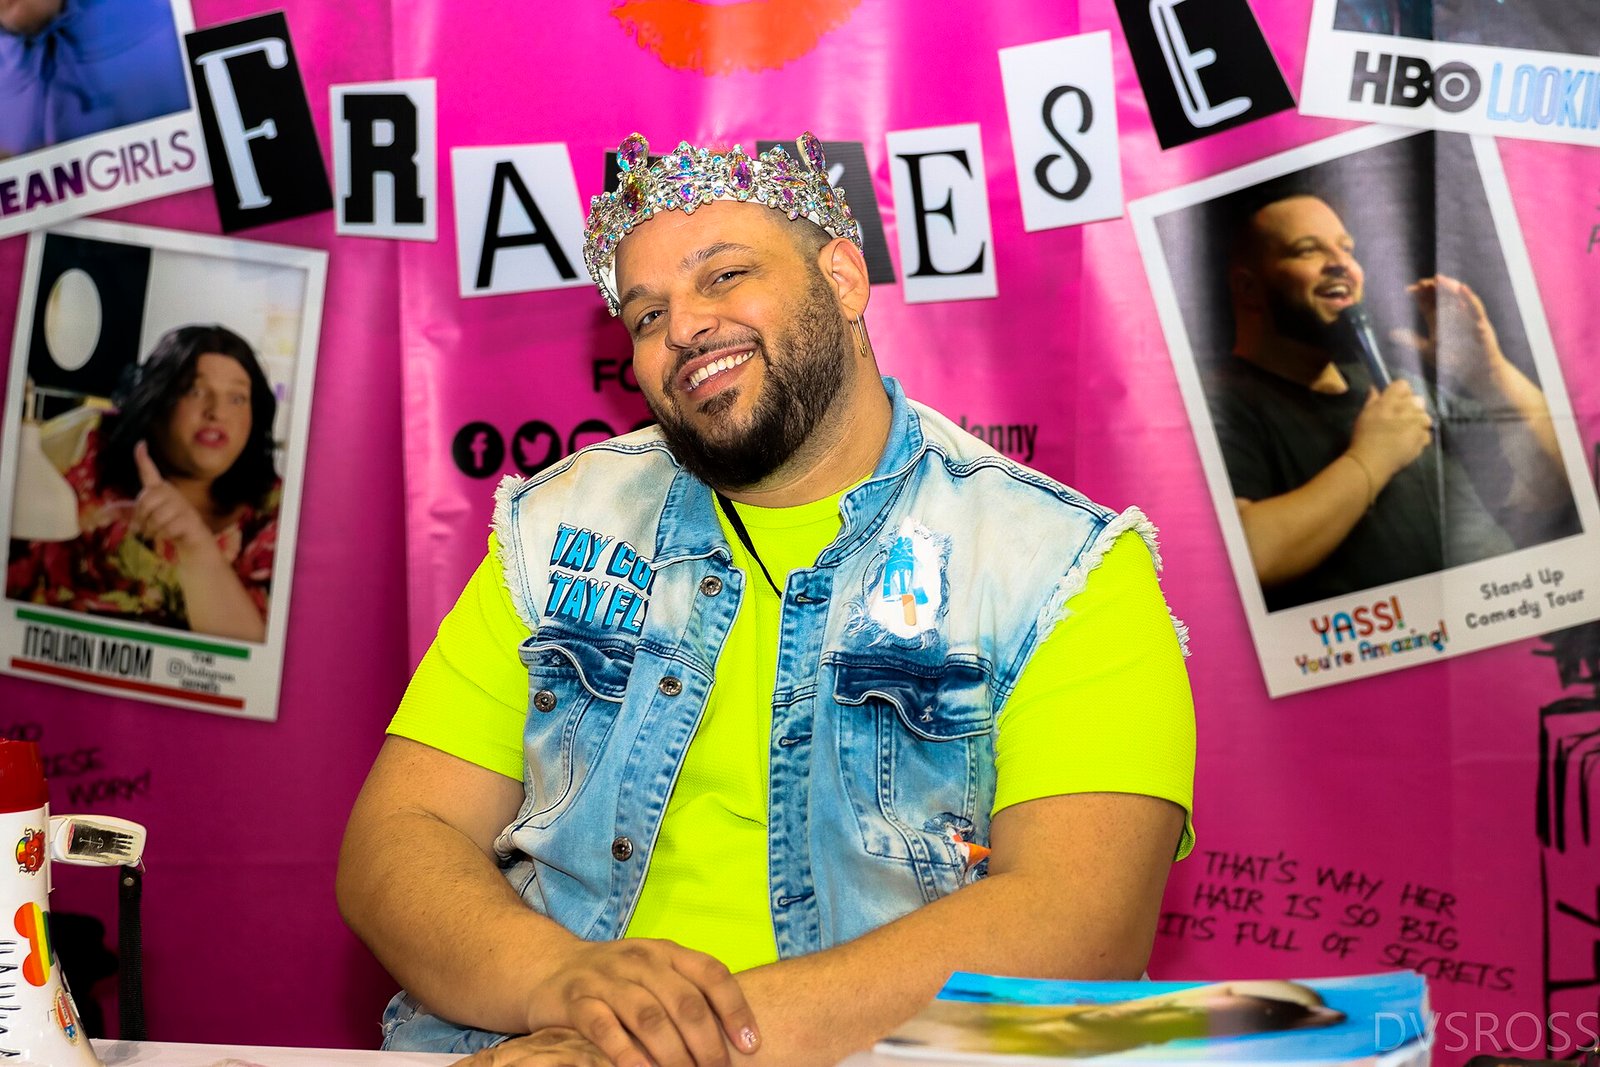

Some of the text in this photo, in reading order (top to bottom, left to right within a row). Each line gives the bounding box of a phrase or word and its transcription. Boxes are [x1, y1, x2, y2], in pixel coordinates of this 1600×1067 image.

[1350, 51, 1481, 113] HBO
[606, 541, 657, 596] CO
[1480, 568, 1564, 600] Stand Up
[601, 583, 651, 637] FL
[1310, 595, 1405, 646] YASS!
[1465, 588, 1584, 629] Comedy Tour
[24, 625, 153, 679] ITALIAN MOM
[1295, 618, 1449, 675] You're Amazing!
[1205, 851, 1456, 919] THAT'S WHY HER
[1159, 912, 1216, 941] IT'S
[1235, 921, 1301, 952] FULL
[1322, 931, 1360, 959] OF
[1193, 882, 1458, 951] HAIR IS SO BIG
